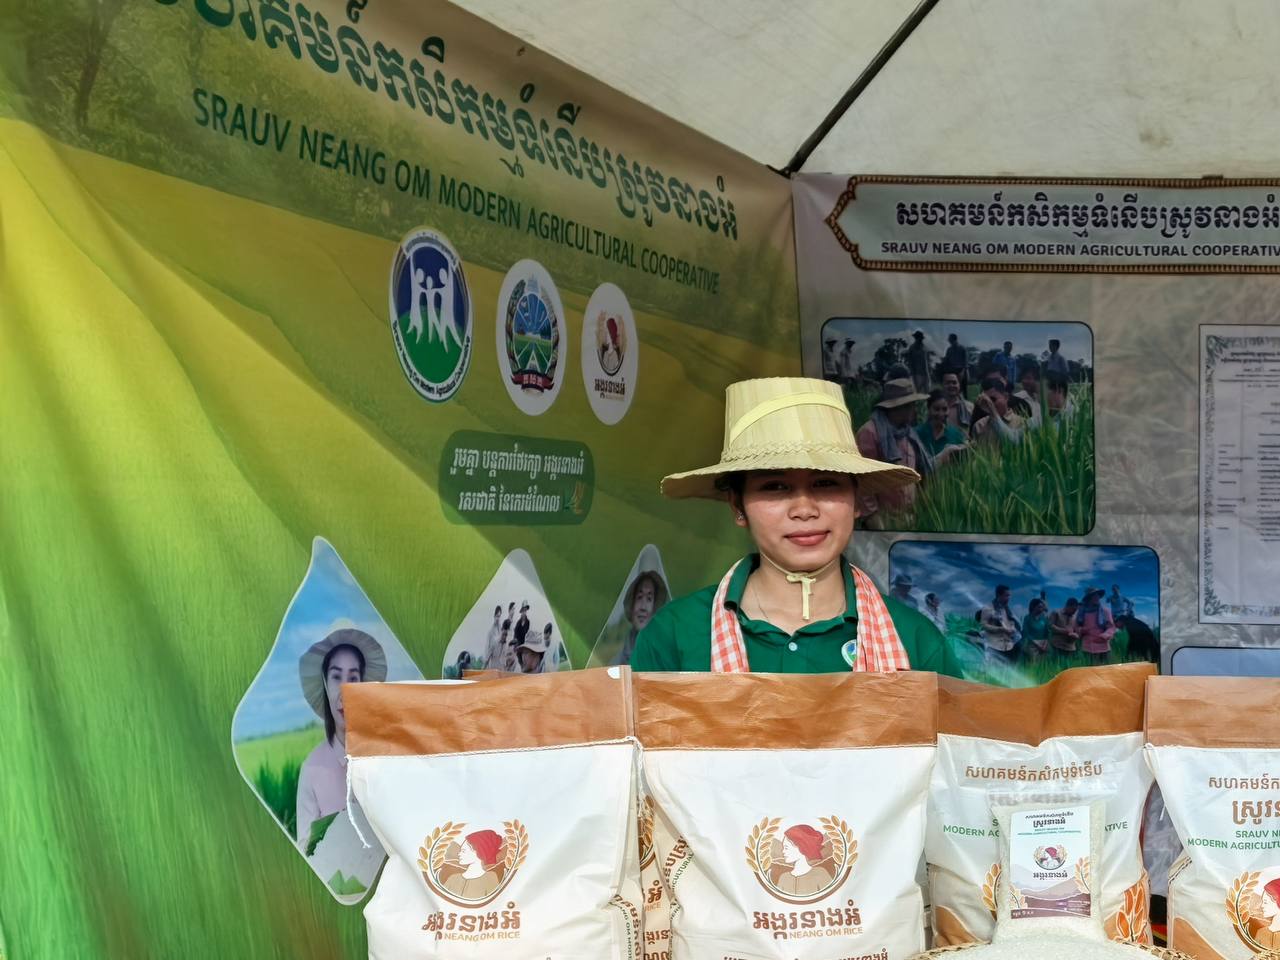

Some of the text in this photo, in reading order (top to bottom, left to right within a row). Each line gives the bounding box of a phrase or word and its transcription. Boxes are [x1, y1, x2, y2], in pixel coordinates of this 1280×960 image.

[193, 88, 291, 151] SRAUV
[300, 125, 386, 185] NEANG
[395, 159, 431, 201] OM
[439, 174, 521, 231] MODERN
[527, 207, 637, 269] AGRICULTURAL
[641, 248, 721, 295] COOPERATIVE
[880, 241, 928, 256] SRAUV
[933, 242, 983, 256] NEANG
[986, 242, 1009, 256] OM
[1013, 243, 1075, 256] MODERN
[1080, 244, 1188, 257] AGRICULTURAL
[943, 824, 985, 837] MODERN
[1235, 830, 1269, 839] SRAUV
[1187, 838, 1228, 848] MODERN
[444, 930, 521, 941] NEANG OM RICE
[790, 927, 863, 939] NEANG OM RICE
